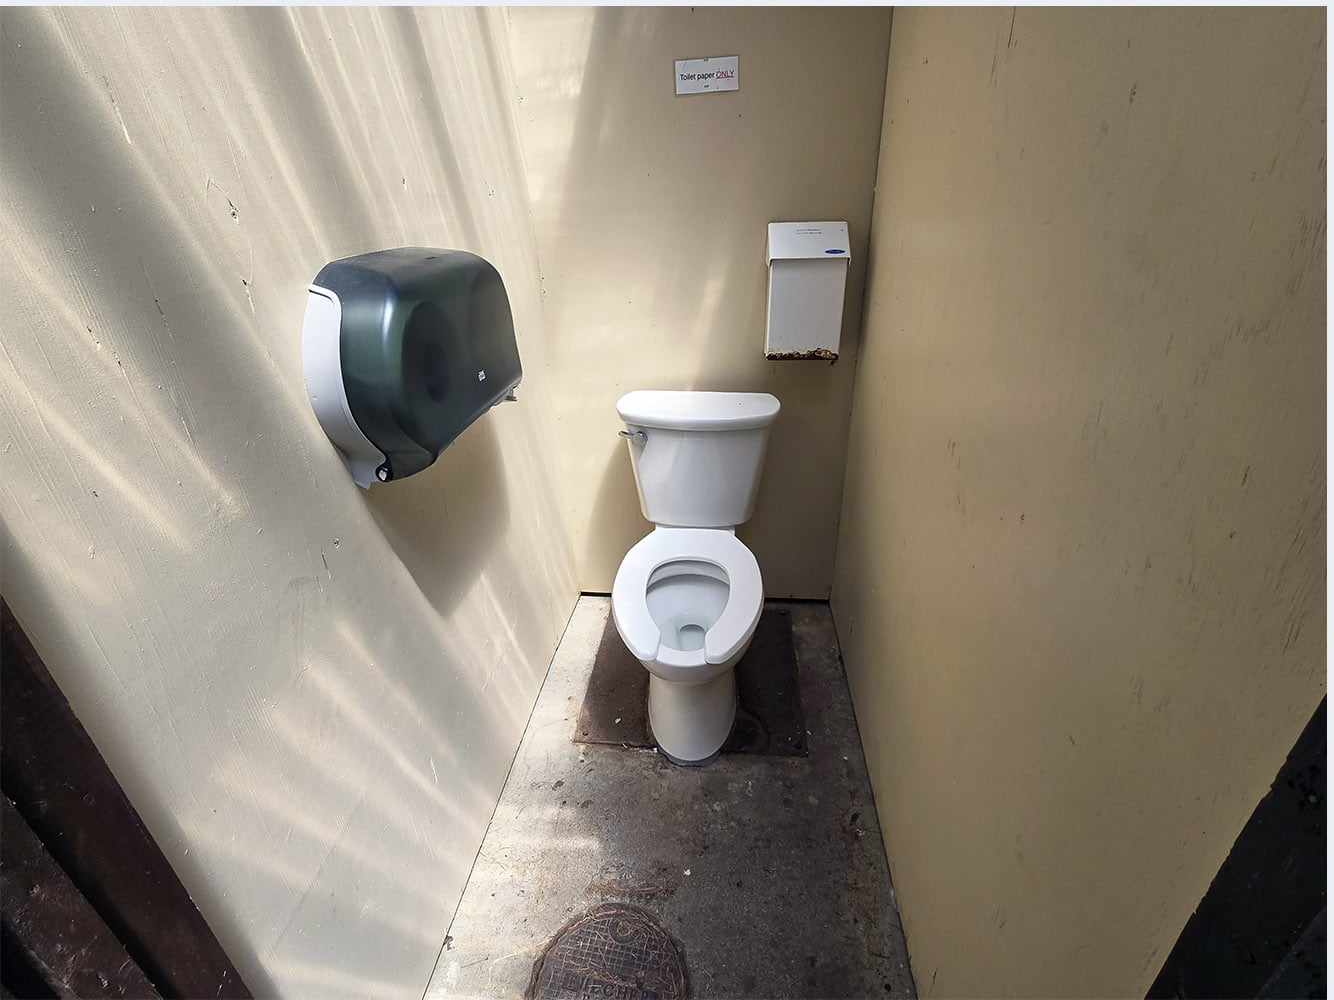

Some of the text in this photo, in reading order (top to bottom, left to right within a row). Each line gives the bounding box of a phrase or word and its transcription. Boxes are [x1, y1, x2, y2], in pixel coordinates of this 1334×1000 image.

[680, 70, 735, 81] Toilet paper ONLY
